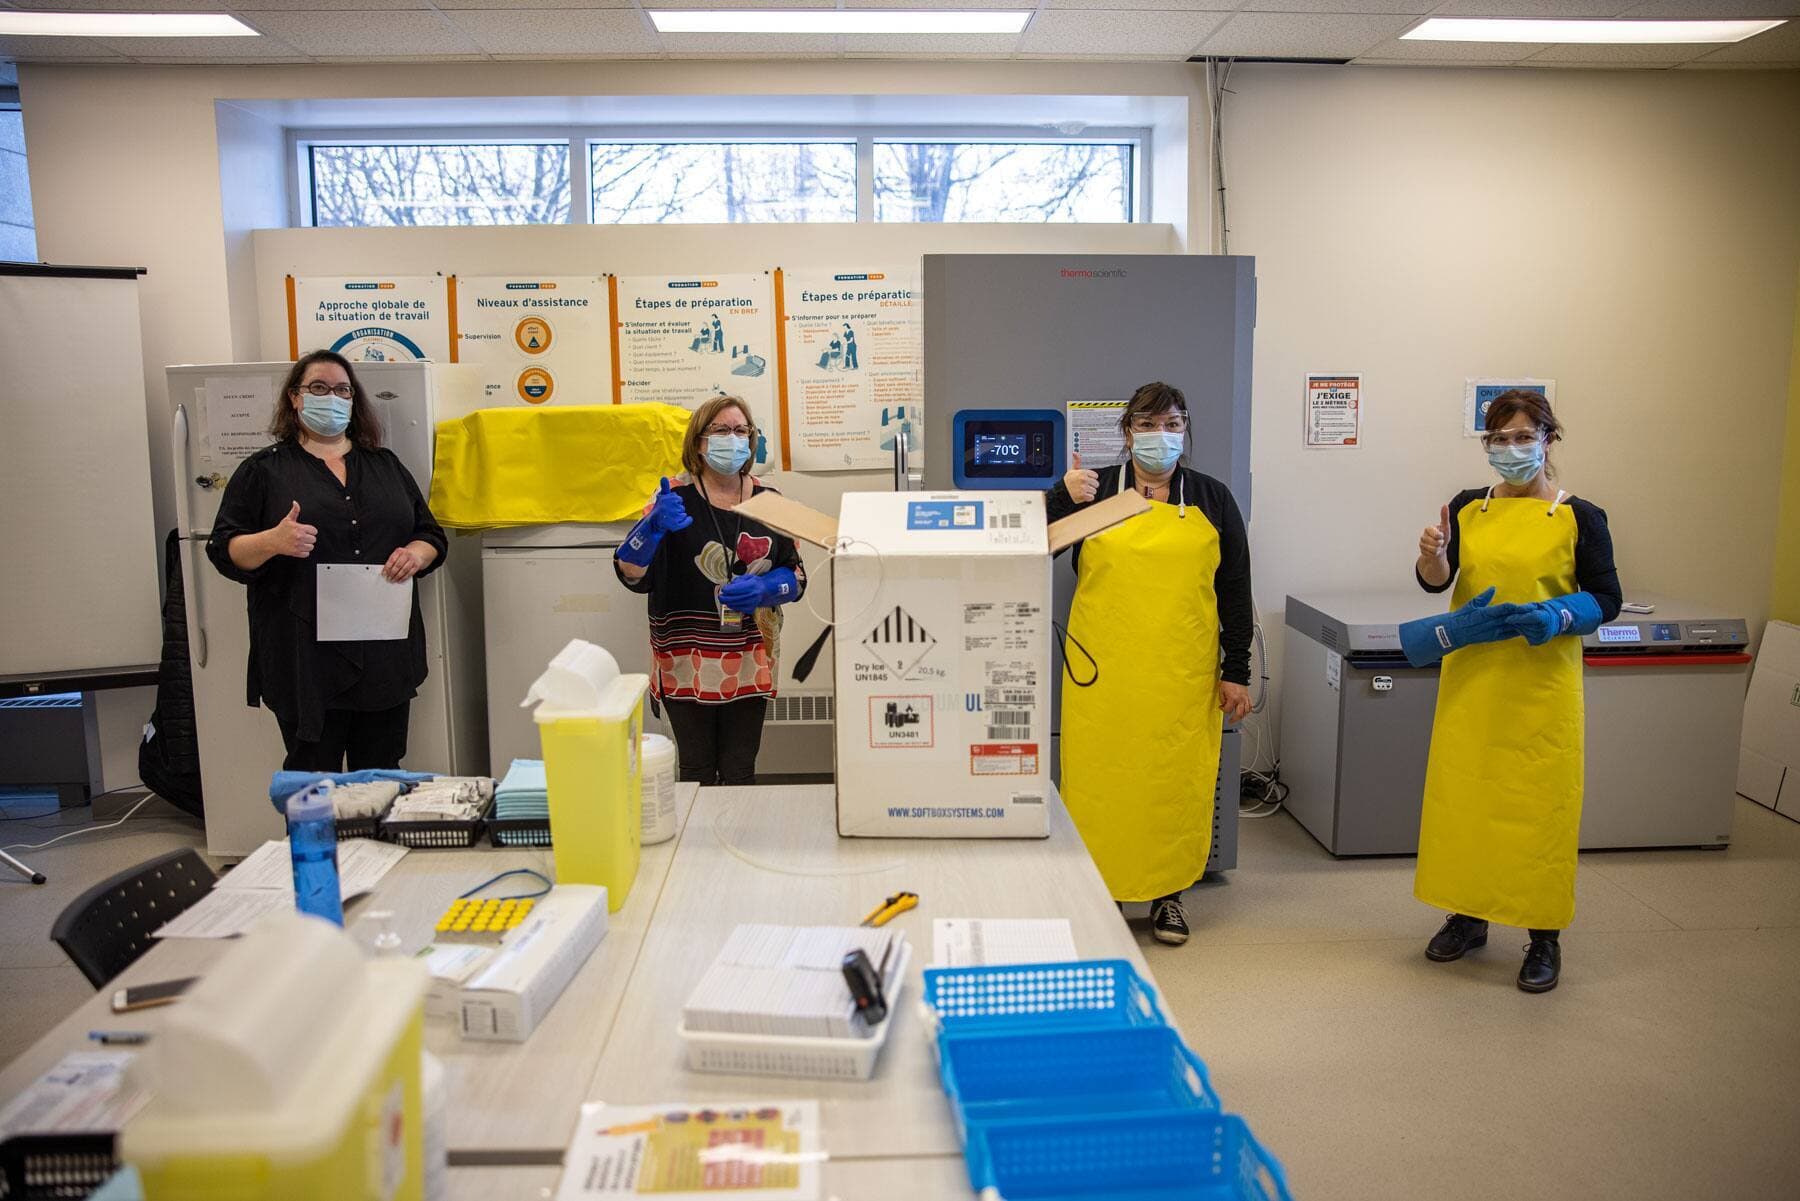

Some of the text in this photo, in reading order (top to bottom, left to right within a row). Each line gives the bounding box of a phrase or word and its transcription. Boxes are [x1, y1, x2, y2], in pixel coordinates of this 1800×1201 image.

[802, 289, 914, 303] Étapes de préparatio
[319, 300, 425, 311] Approche globale de
[477, 297, 589, 307] Niveaux d'assistance
[635, 297, 753, 309] Étapes de préparation
[316, 311, 430, 321] la situation de travail
[352, 328, 394, 339] ORGANISATION
[464, 333, 501, 341] Supervision
[1316, 392, 1351, 400] J'EXIGE
[990, 444, 1020, 456] -70°C
[1599, 627, 1638, 636] Thermo
[855, 663, 885, 672] Dry Ice
[855, 674, 888, 682] UN1845
[888, 807, 1004, 818] WWW.SOFTBOXSYSTEMS.COM
